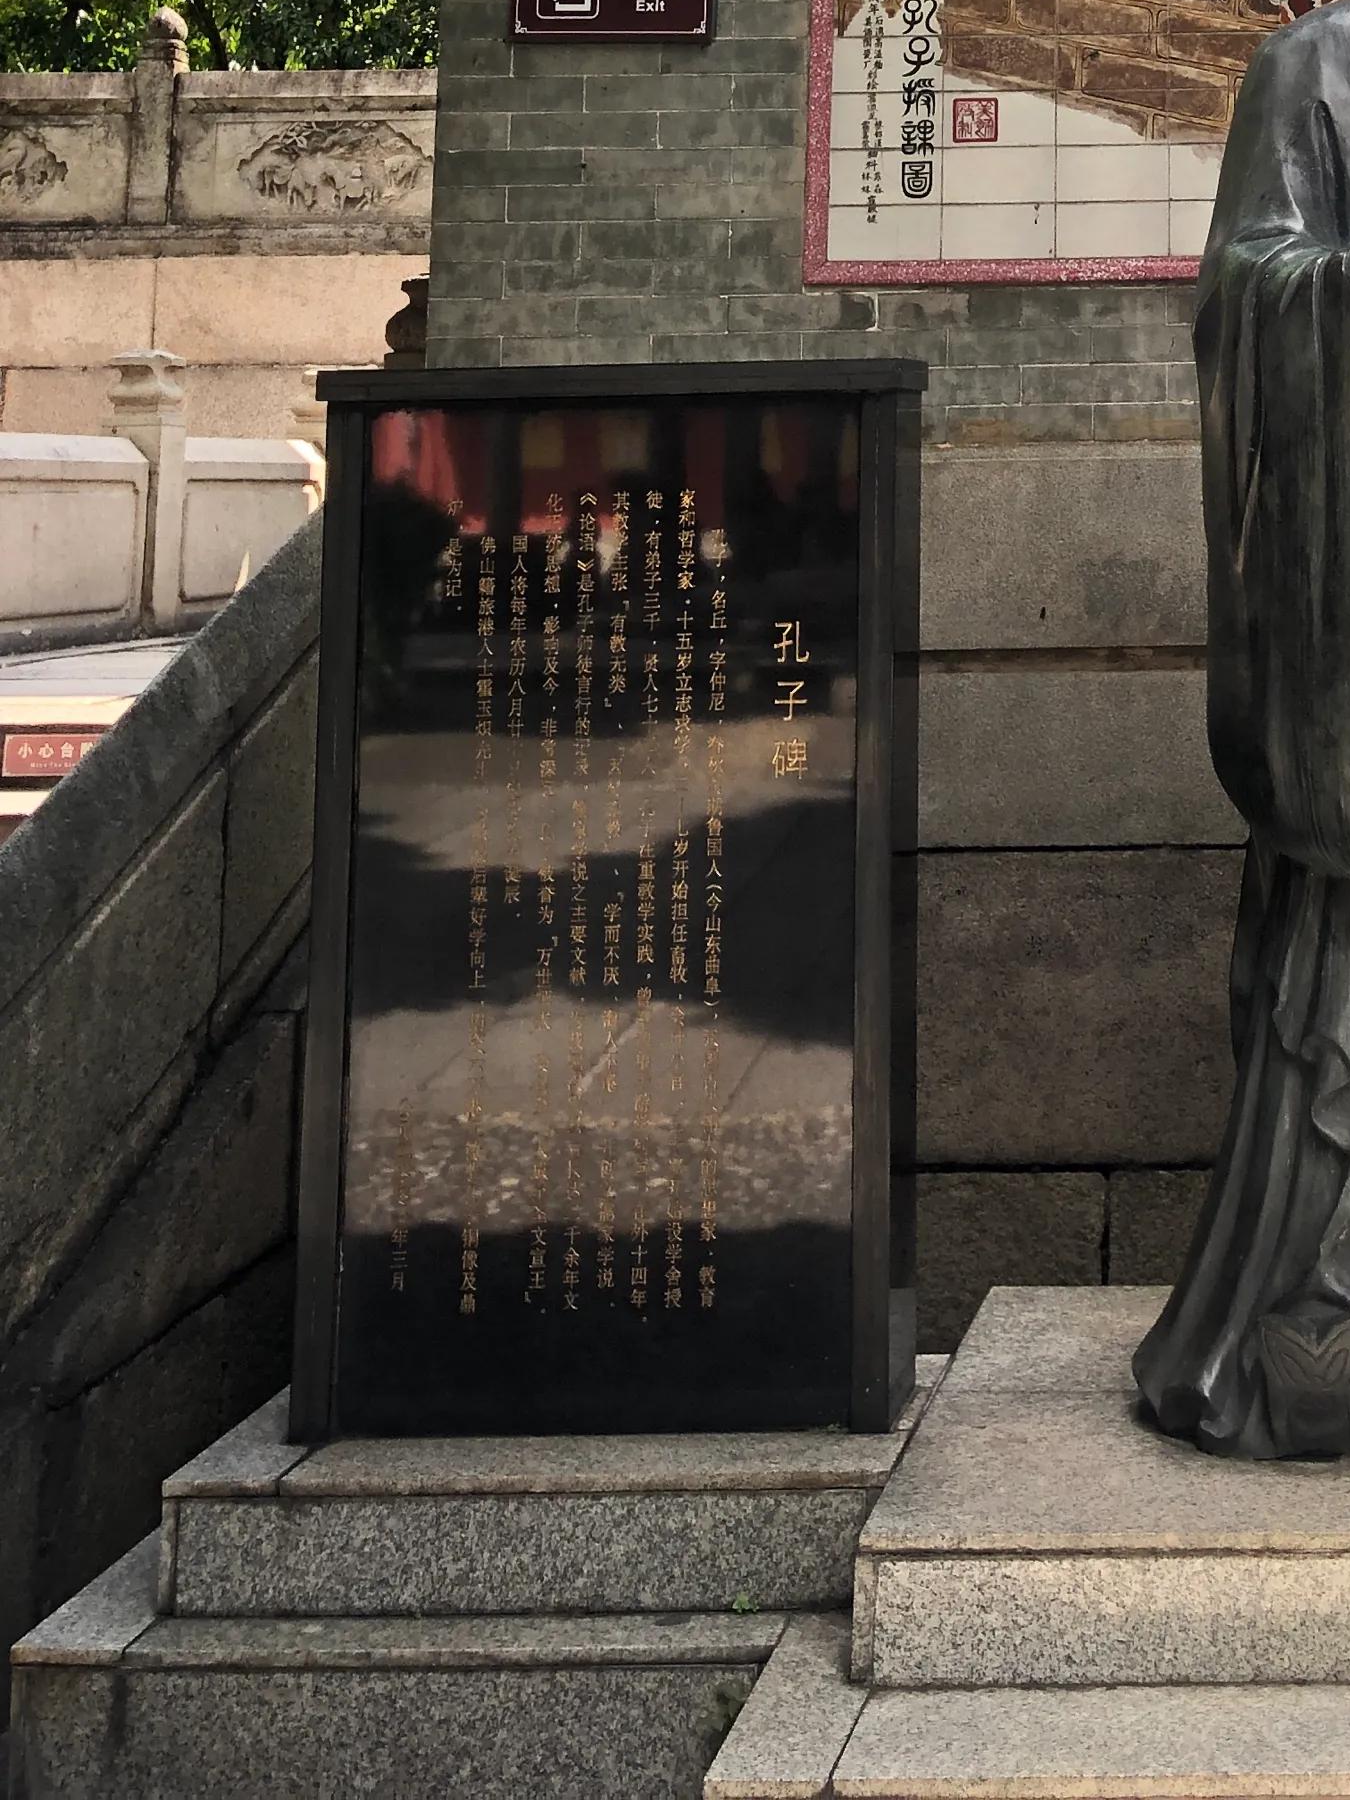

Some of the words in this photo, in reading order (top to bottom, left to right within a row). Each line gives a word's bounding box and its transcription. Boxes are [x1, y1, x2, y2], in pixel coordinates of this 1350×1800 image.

[635, 0, 666, 12] Exit
[771, 619, 810, 781] 孔子碑
